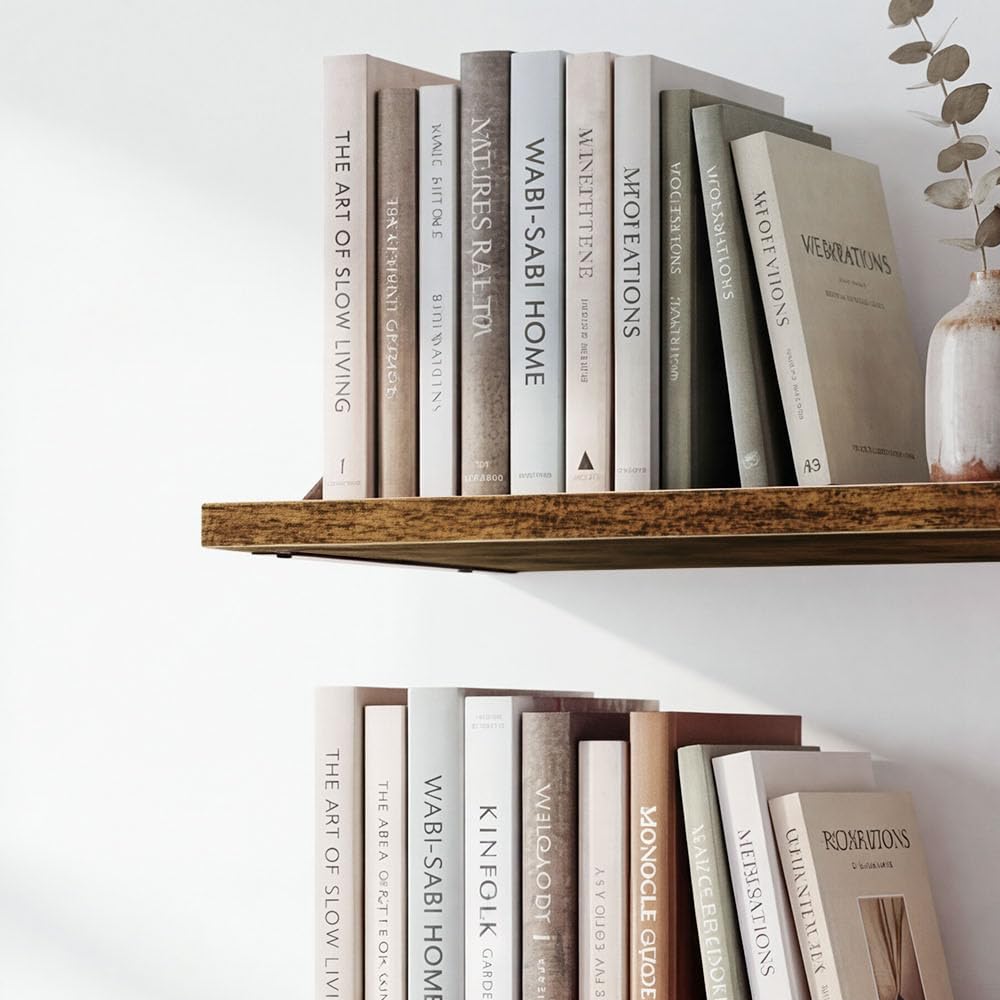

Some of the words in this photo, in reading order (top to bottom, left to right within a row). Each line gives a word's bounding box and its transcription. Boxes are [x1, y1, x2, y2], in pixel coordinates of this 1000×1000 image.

[334, 131, 351, 171] THE
[334, 182, 351, 221] ART
[525, 138, 545, 287] WABI-SABI
[334, 230, 351, 257] OF
[334, 268, 351, 329] SLOW
[525, 301, 545, 386] HOME
[334, 340, 351, 413] LIVING
[325, 749, 340, 790] THE
[325, 800, 340, 838] ART
[378, 781, 389, 811] THE
[325, 847, 340, 874] OF
[424, 776, 444, 913] WABI-SABI
[479, 806, 498, 937] KINFOLK
[325, 886, 340, 948] SLOW
